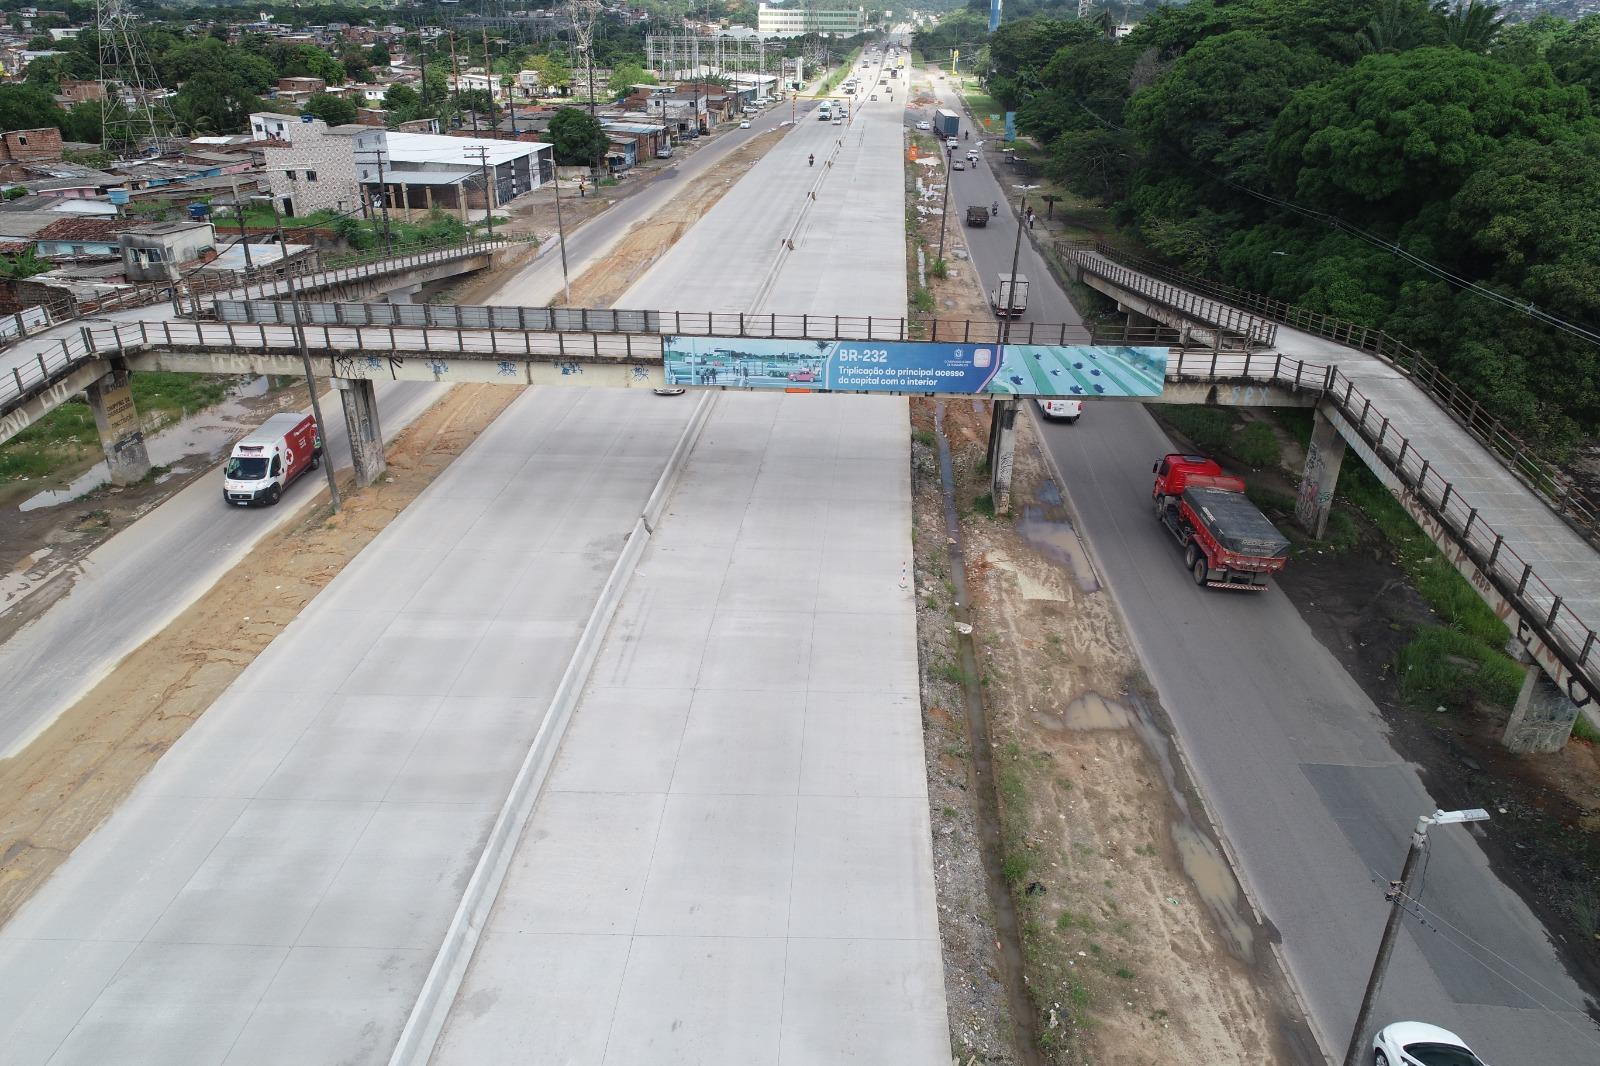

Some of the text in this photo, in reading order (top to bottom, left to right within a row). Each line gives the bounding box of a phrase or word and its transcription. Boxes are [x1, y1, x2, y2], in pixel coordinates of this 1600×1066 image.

[839, 349, 888, 362] BR-232
[838, 366, 884, 376] Triplicação
[885, 367, 896, 375] do
[897, 368, 934, 377] principal
[838, 376, 849, 384] da
[850, 377, 880, 386] capital
[907, 377, 938, 386] interior
